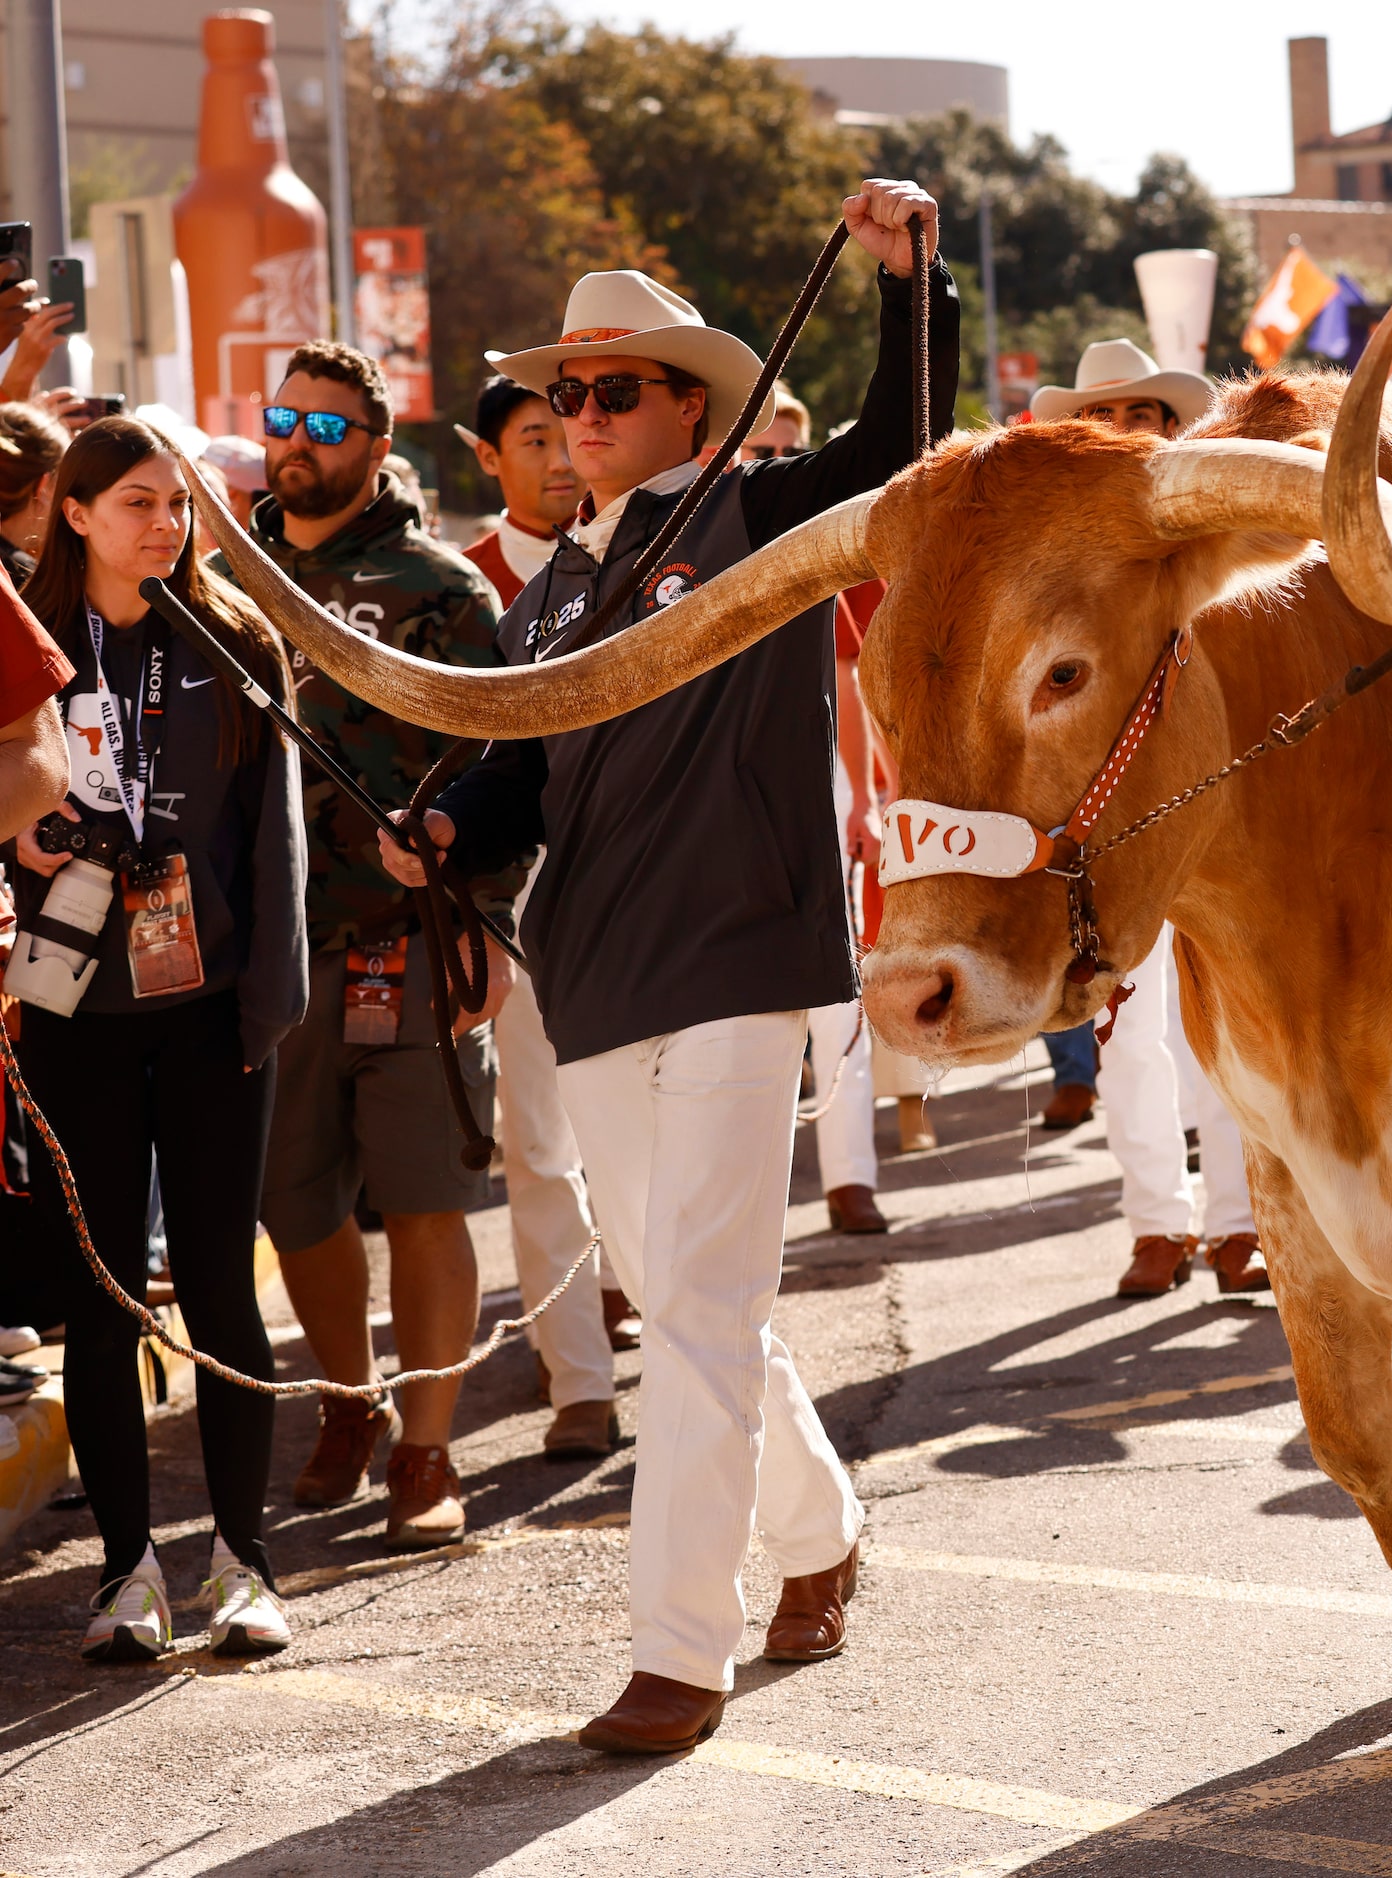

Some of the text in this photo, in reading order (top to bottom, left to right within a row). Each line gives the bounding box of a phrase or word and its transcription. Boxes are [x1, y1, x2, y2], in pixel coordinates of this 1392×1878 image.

[643, 562, 698, 597] TEXAS FOOTBALL
[148, 646, 164, 704] SONY
[101, 701, 113, 721] ALL
[105, 721, 120, 749] GAS.
[882, 813, 977, 869] VO
